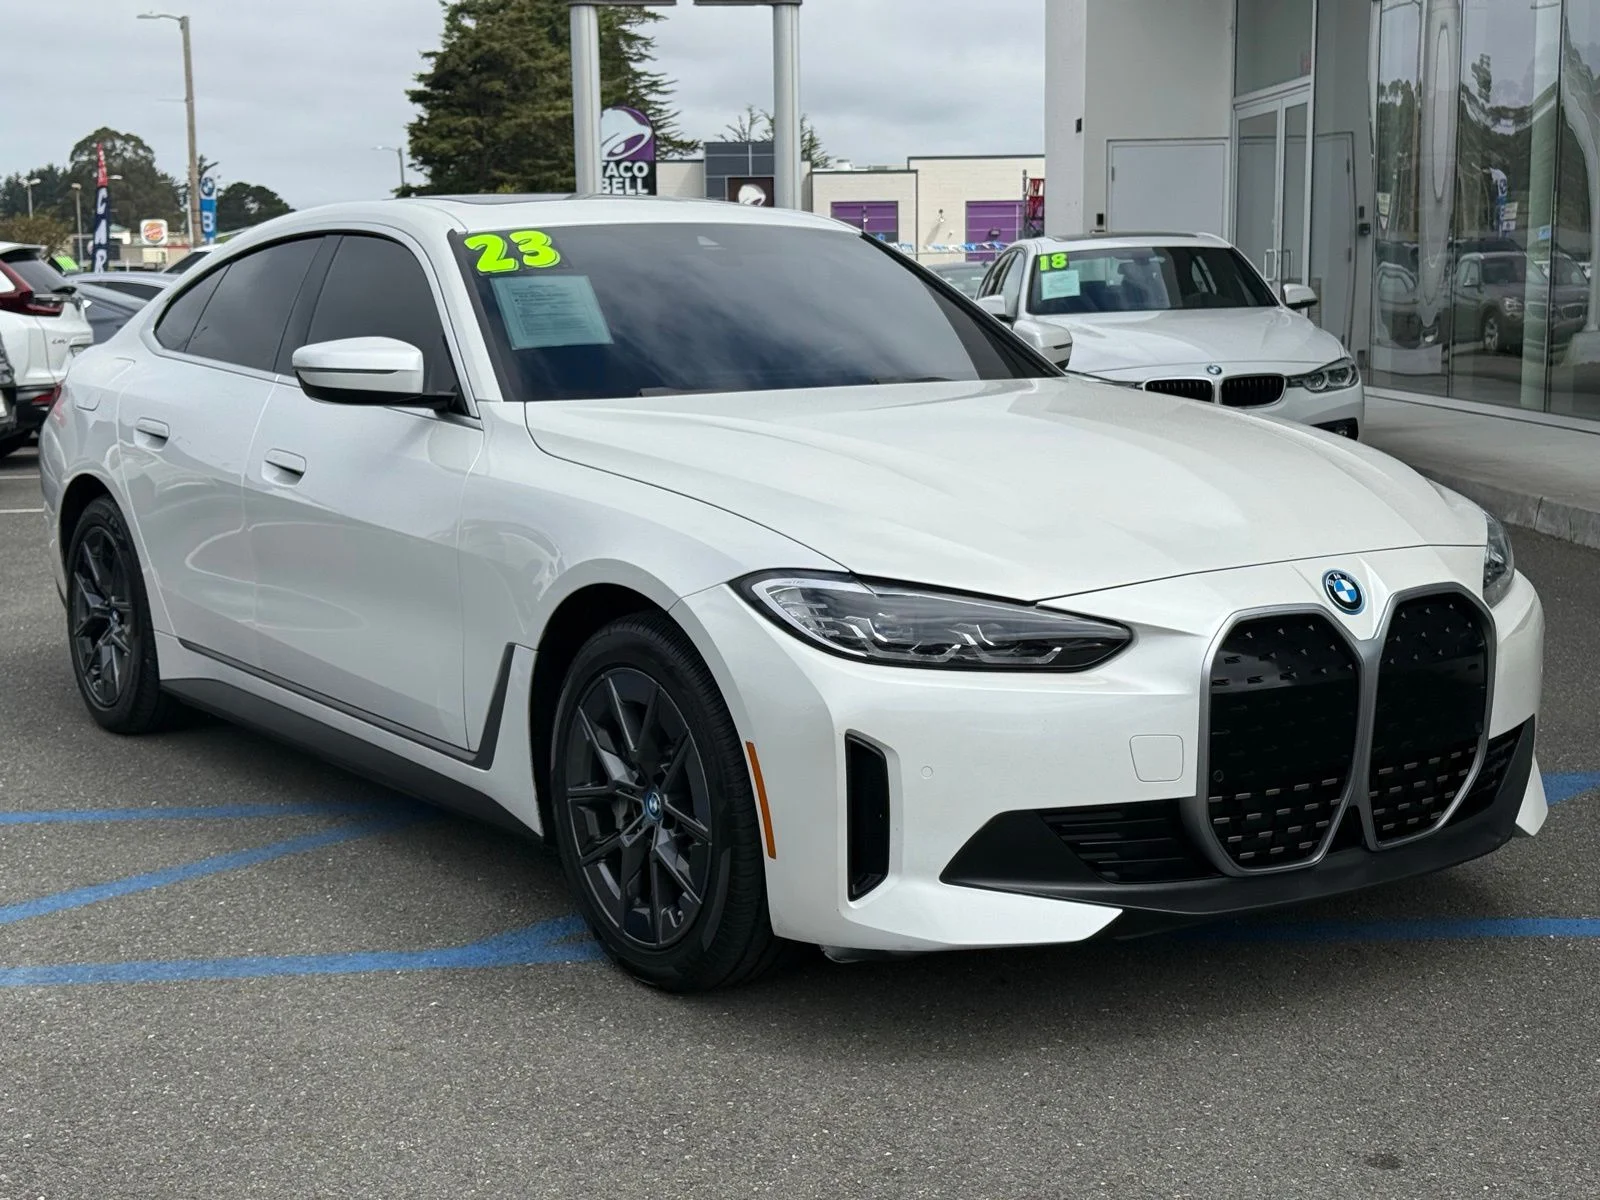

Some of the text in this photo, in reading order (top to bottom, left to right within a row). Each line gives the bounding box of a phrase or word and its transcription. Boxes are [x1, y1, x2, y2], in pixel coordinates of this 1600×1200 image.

[601, 178, 650, 196] BELL
[464, 230, 561, 273] 23
[1039, 252, 1069, 272] 18
